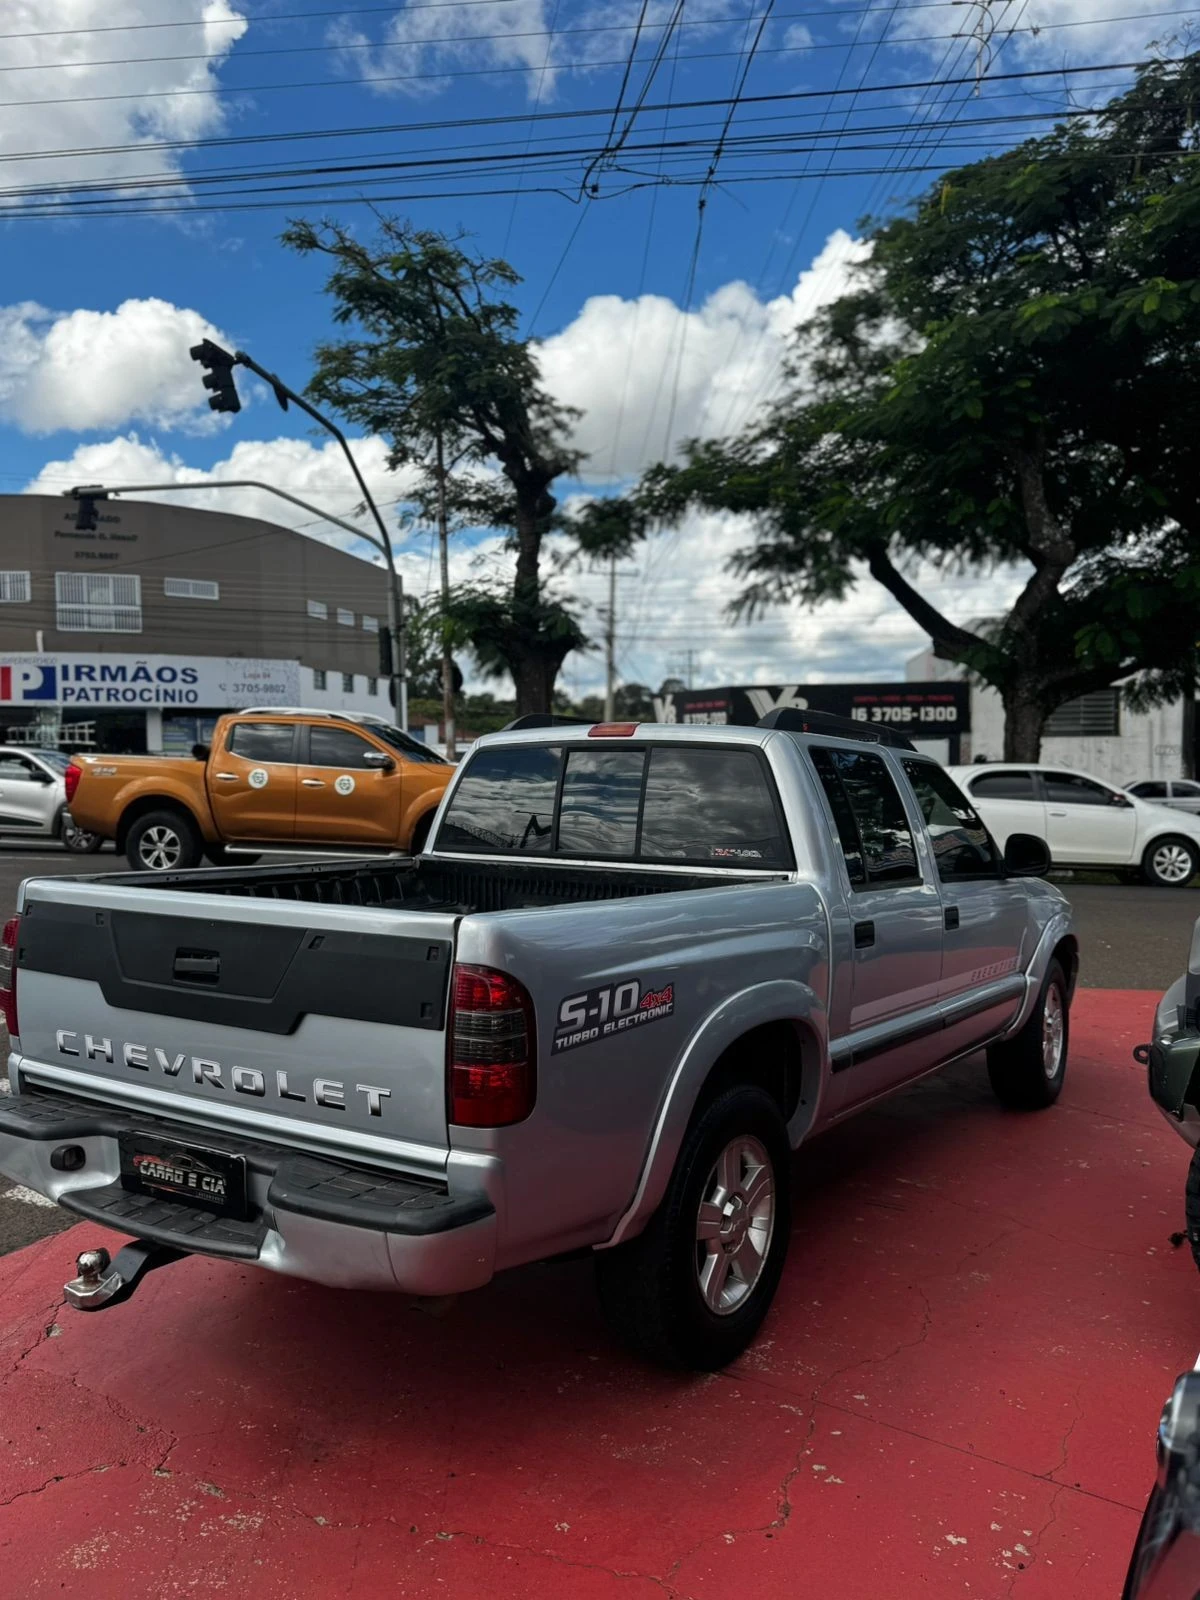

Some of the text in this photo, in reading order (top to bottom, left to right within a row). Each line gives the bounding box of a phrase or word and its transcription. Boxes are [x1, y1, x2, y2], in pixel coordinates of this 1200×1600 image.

[61, 661, 199, 684] IRMÃOS
[62, 686, 199, 703] PATROCÍNIO
[851, 706, 958, 722] 16 3705-1300
[556, 981, 673, 1035] S-10 4x4
[556, 1003, 673, 1049] TURBO ELECTRONIC
[55, 1029, 392, 1117] CHEVROLET
[140, 1161, 225, 1194] CARRO E CIA
